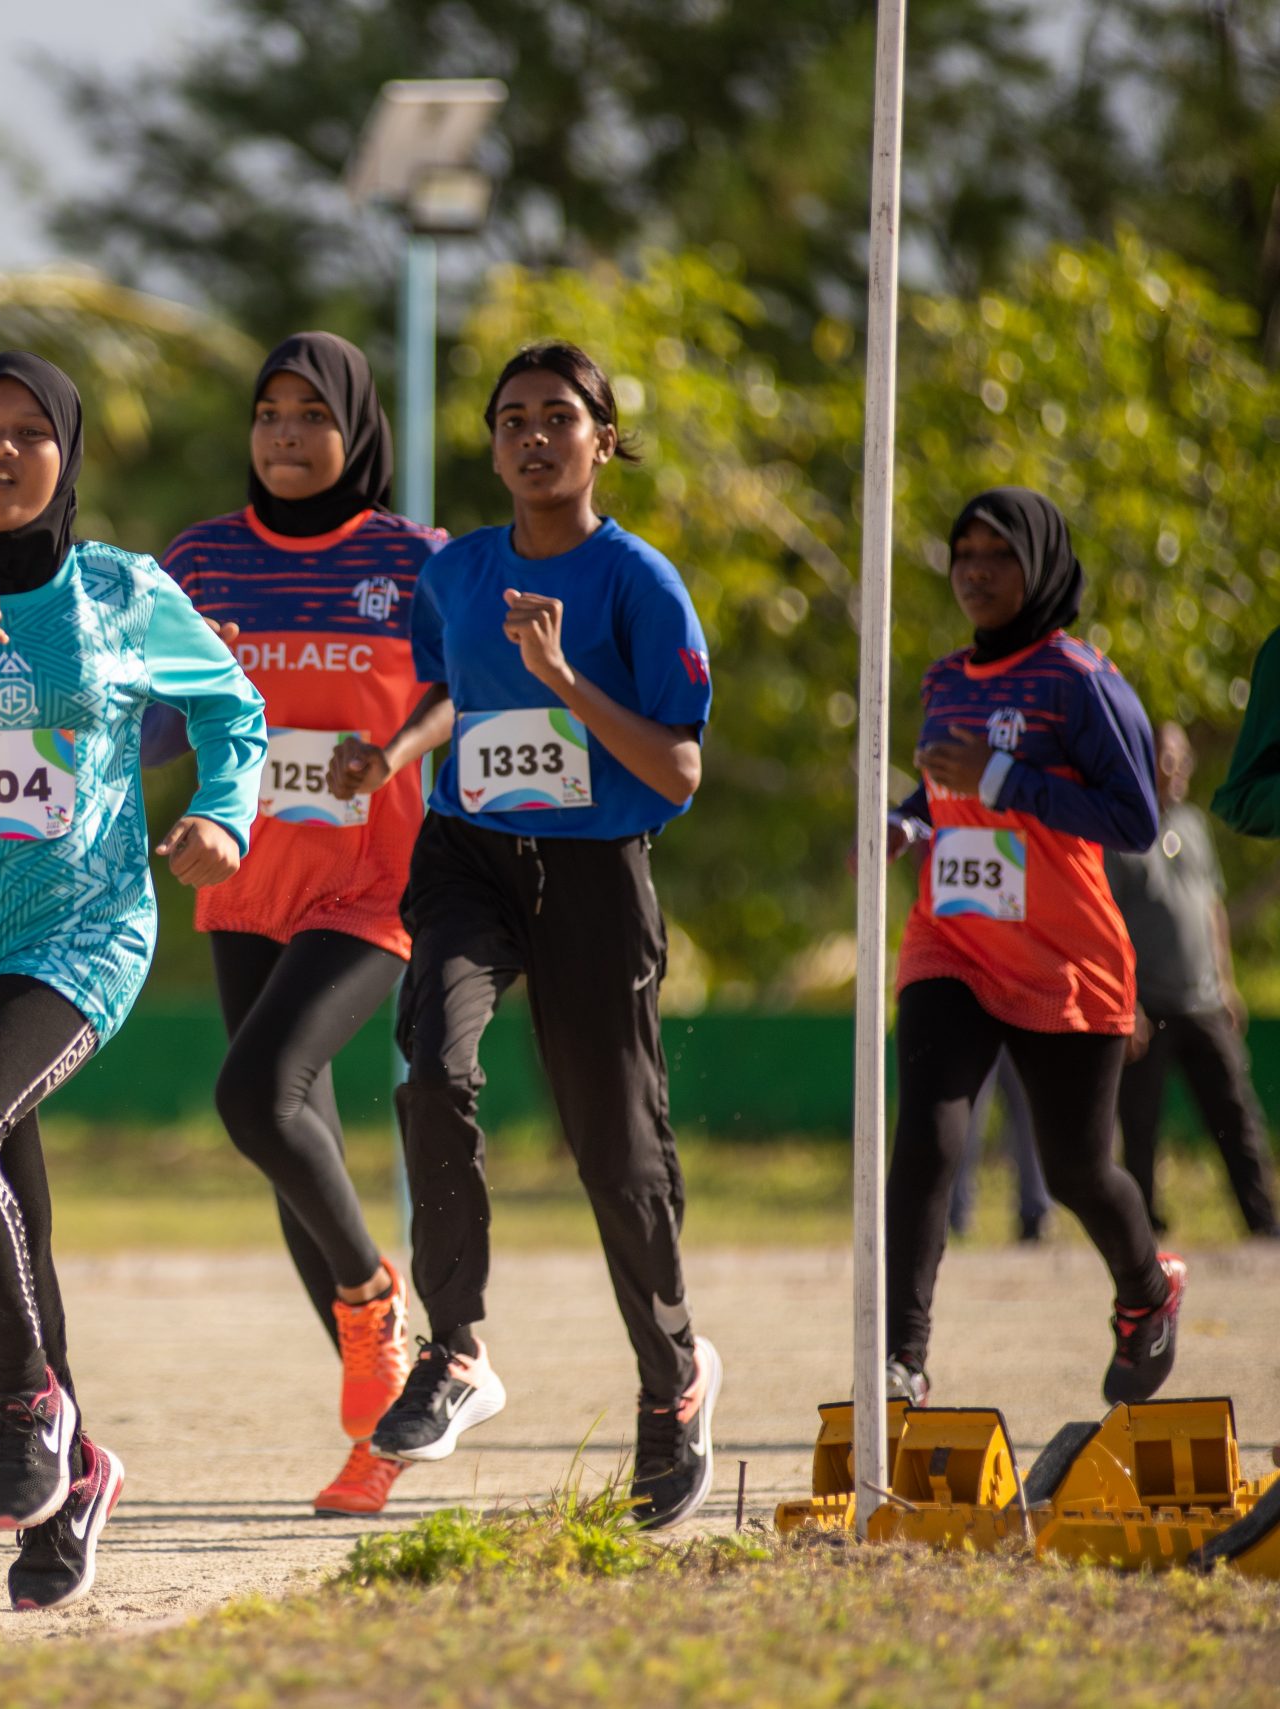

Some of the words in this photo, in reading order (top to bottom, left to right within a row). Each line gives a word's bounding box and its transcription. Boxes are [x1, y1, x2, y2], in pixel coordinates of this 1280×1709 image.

[479, 742, 564, 778] 1333
[271, 761, 331, 795] 125
[938, 859, 1002, 888] 1253
